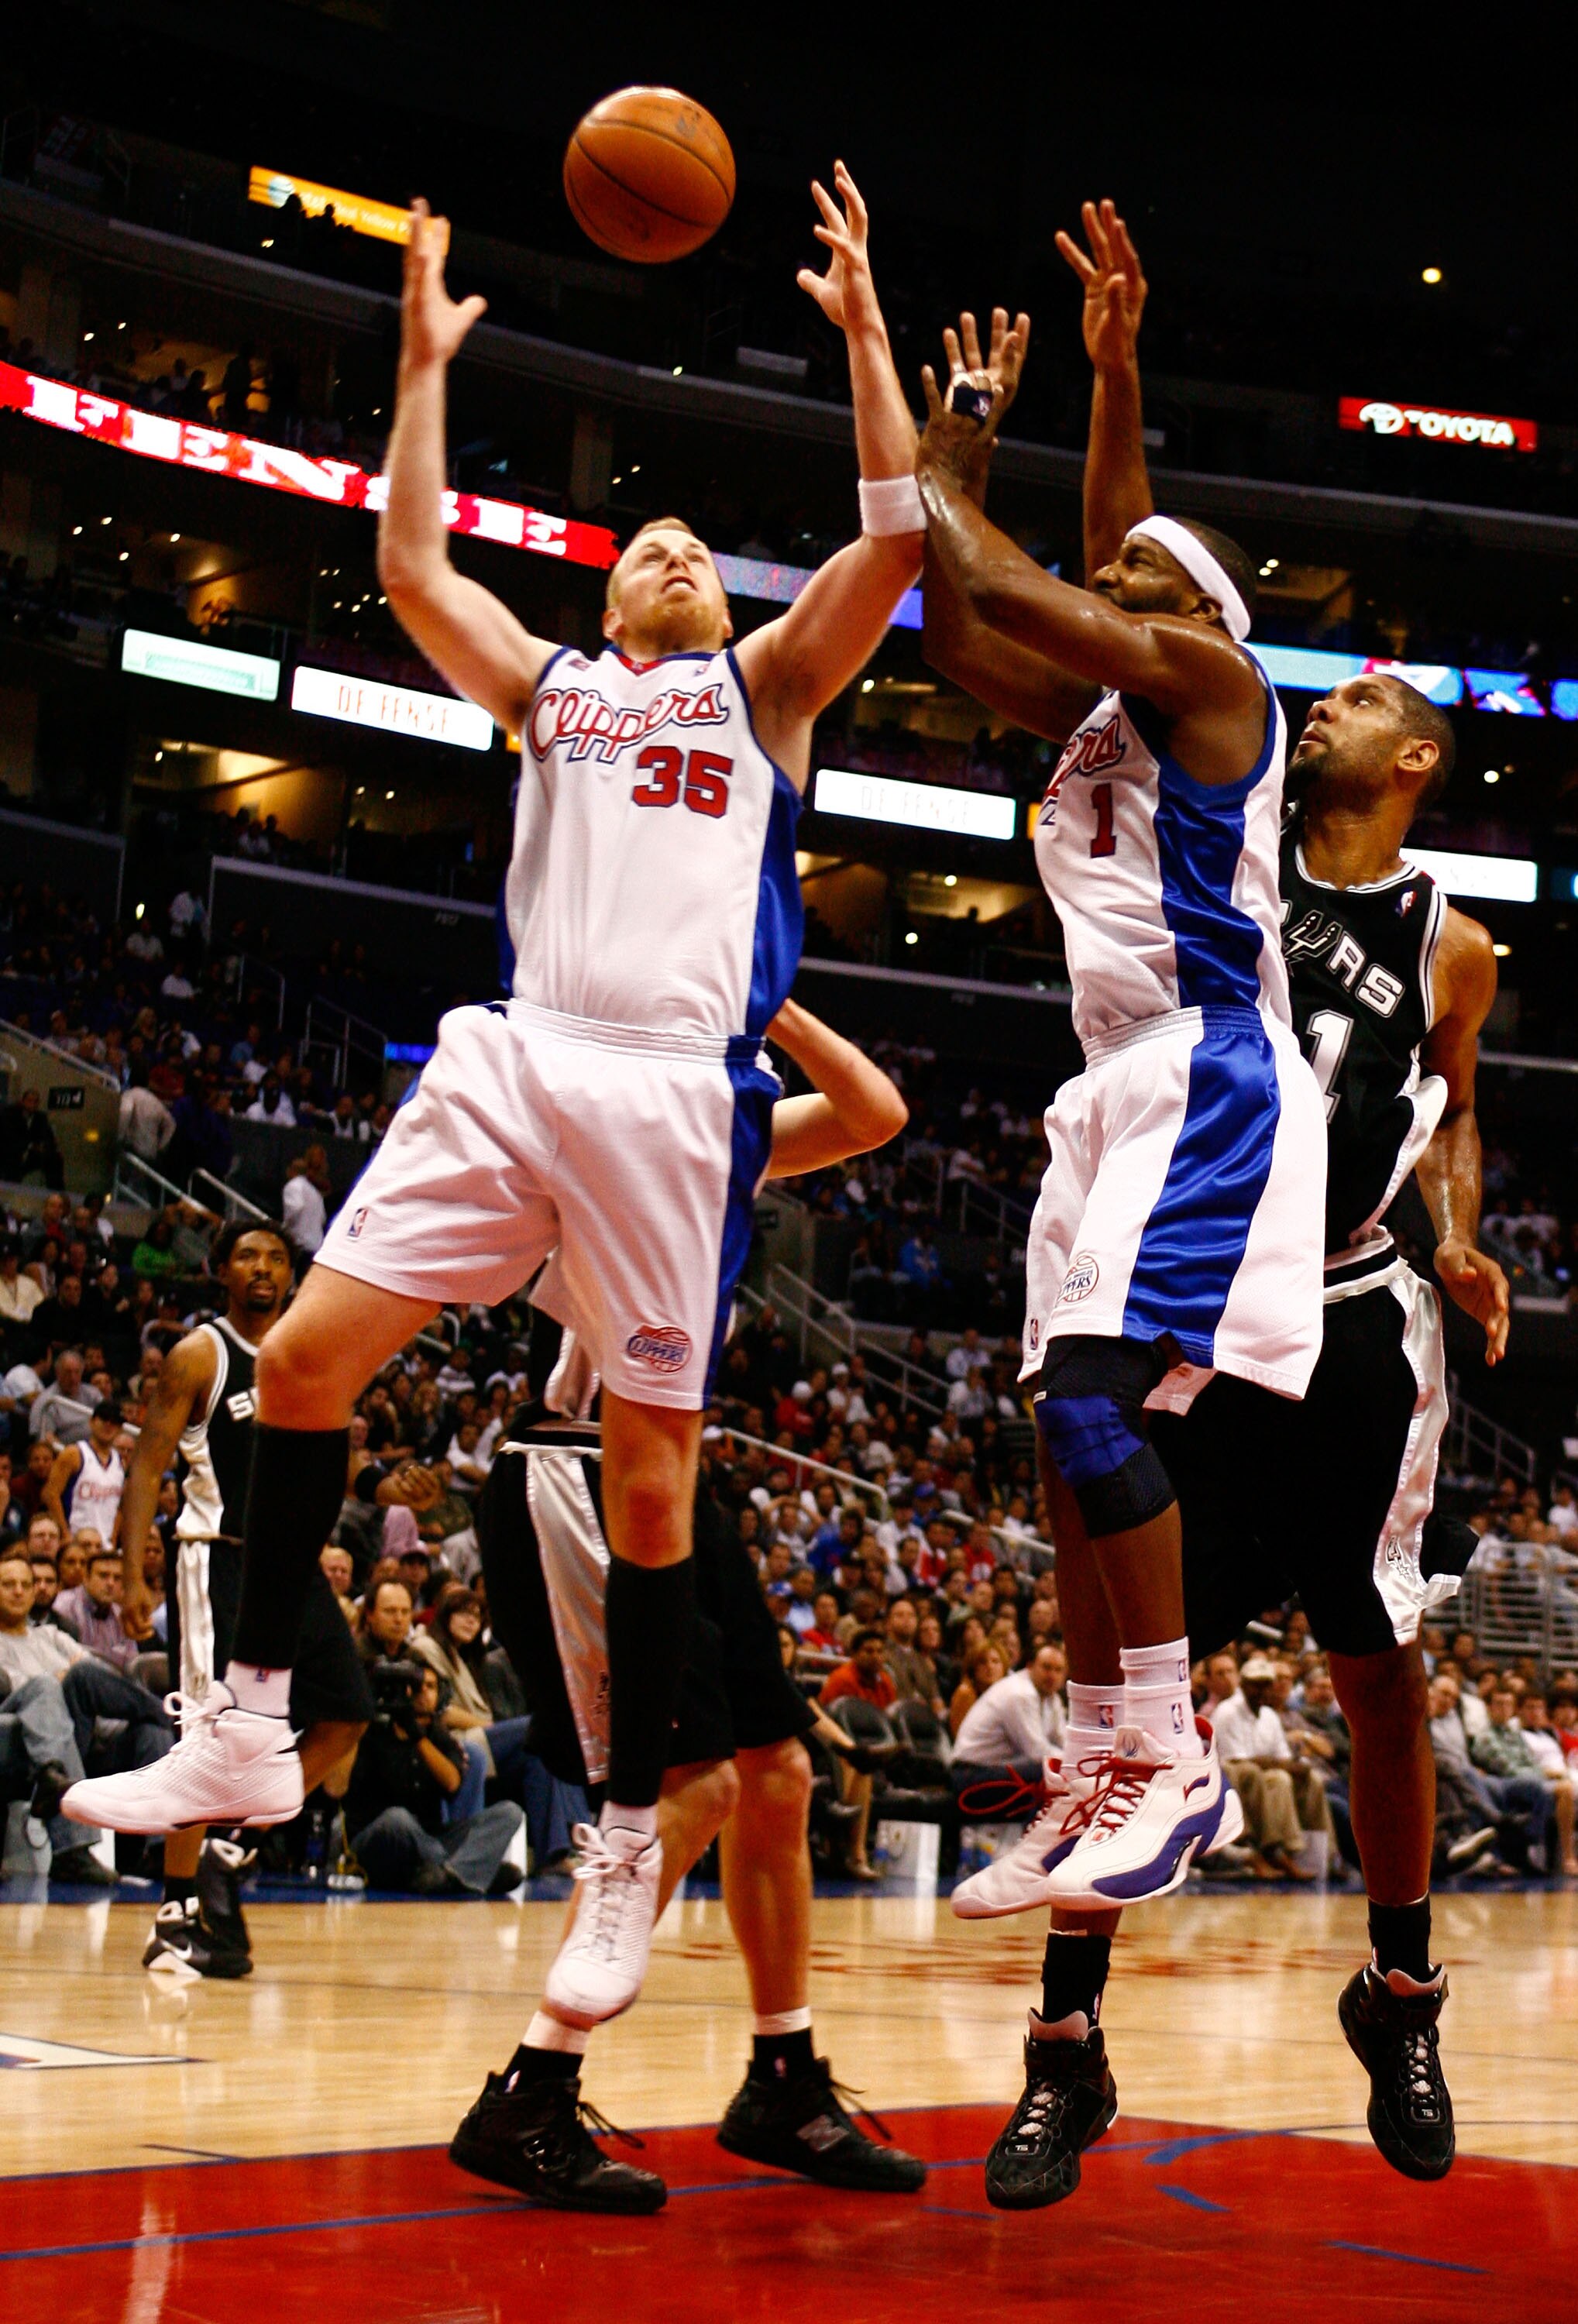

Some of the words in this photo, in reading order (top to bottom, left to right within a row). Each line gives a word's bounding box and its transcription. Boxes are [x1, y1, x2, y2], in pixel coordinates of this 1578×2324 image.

[1404, 409, 1515, 445] TOYOTA
[528, 683, 730, 764] Clippers
[631, 745, 734, 819] 35
[1090, 782, 1116, 859] 1
[1281, 899, 1406, 1018] URS
